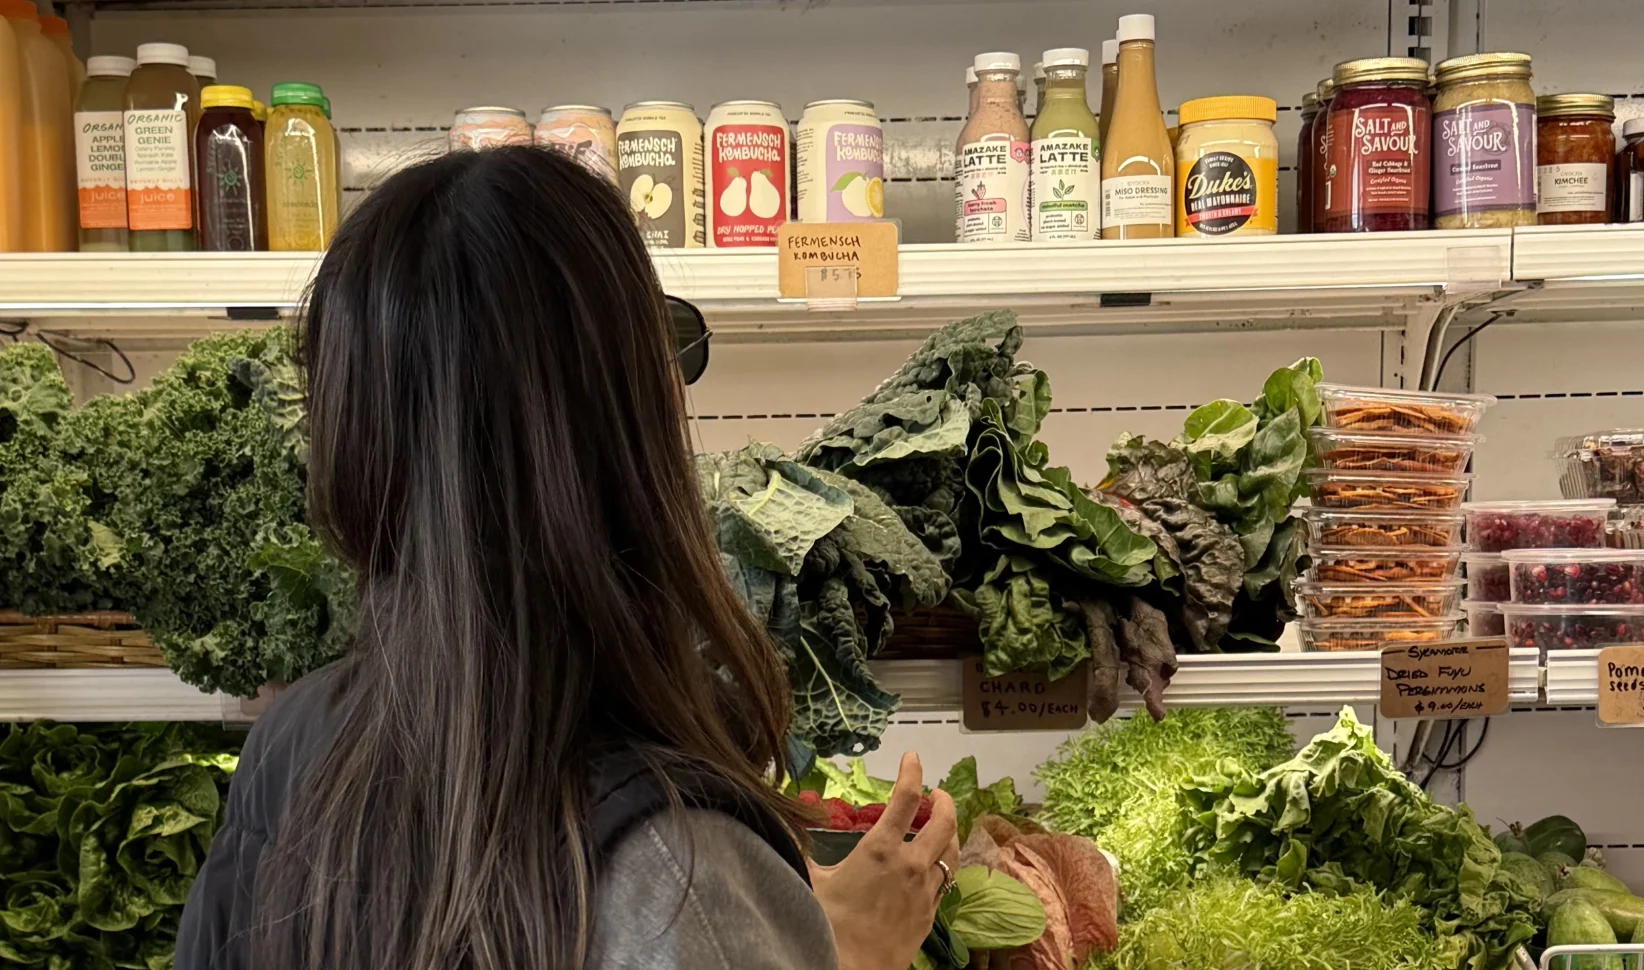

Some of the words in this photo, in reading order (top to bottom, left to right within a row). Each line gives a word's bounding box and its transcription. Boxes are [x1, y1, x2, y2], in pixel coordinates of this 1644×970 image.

[127, 114, 183, 125] ORGANIC
[83, 123, 124, 133] ORGAN
[135, 126, 173, 134] GREEN
[1356, 118, 1391, 137] SALT
[1391, 121, 1407, 132] AND
[1442, 119, 1472, 140] SALT
[1473, 120, 1490, 131] AND
[138, 136, 172, 145] GENIE
[618, 136, 676, 156] FERMENSCH
[716, 132, 780, 148] FERMENSCH
[1362, 135, 1418, 155] SAVOUR
[1448, 132, 1506, 156] SAVOUR
[964, 146, 1006, 155] AMAZAKE
[1040, 143, 1088, 152] AMAZAKE
[88, 154, 124, 162] DOUBL
[964, 154, 1006, 168] LATTE
[1040, 152, 1088, 163] LATTE
[91, 163, 125, 171] GINGE
[1188, 171, 1251, 199] Duke's
[1555, 177, 1588, 185] KIMCHEE
[140, 189, 175, 204] juice
[1114, 188, 1134, 196] MISO
[1190, 199, 1206, 212] REAL
[1206, 194, 1250, 208] MAYONNAISE
[717, 226, 731, 235] DRY
[734, 224, 764, 234] HOPPED
[766, 225, 778, 234] PE
[788, 236, 862, 248] FERMENSCH
[794, 252, 860, 261] KOMBUCHA
[1408, 646, 1468, 660] SYCAMORE
[1385, 668, 1428, 680] DRIED
[1438, 666, 1471, 680] FUYU
[980, 681, 1046, 694] CHARD
[1610, 679, 1644, 692] seeds
